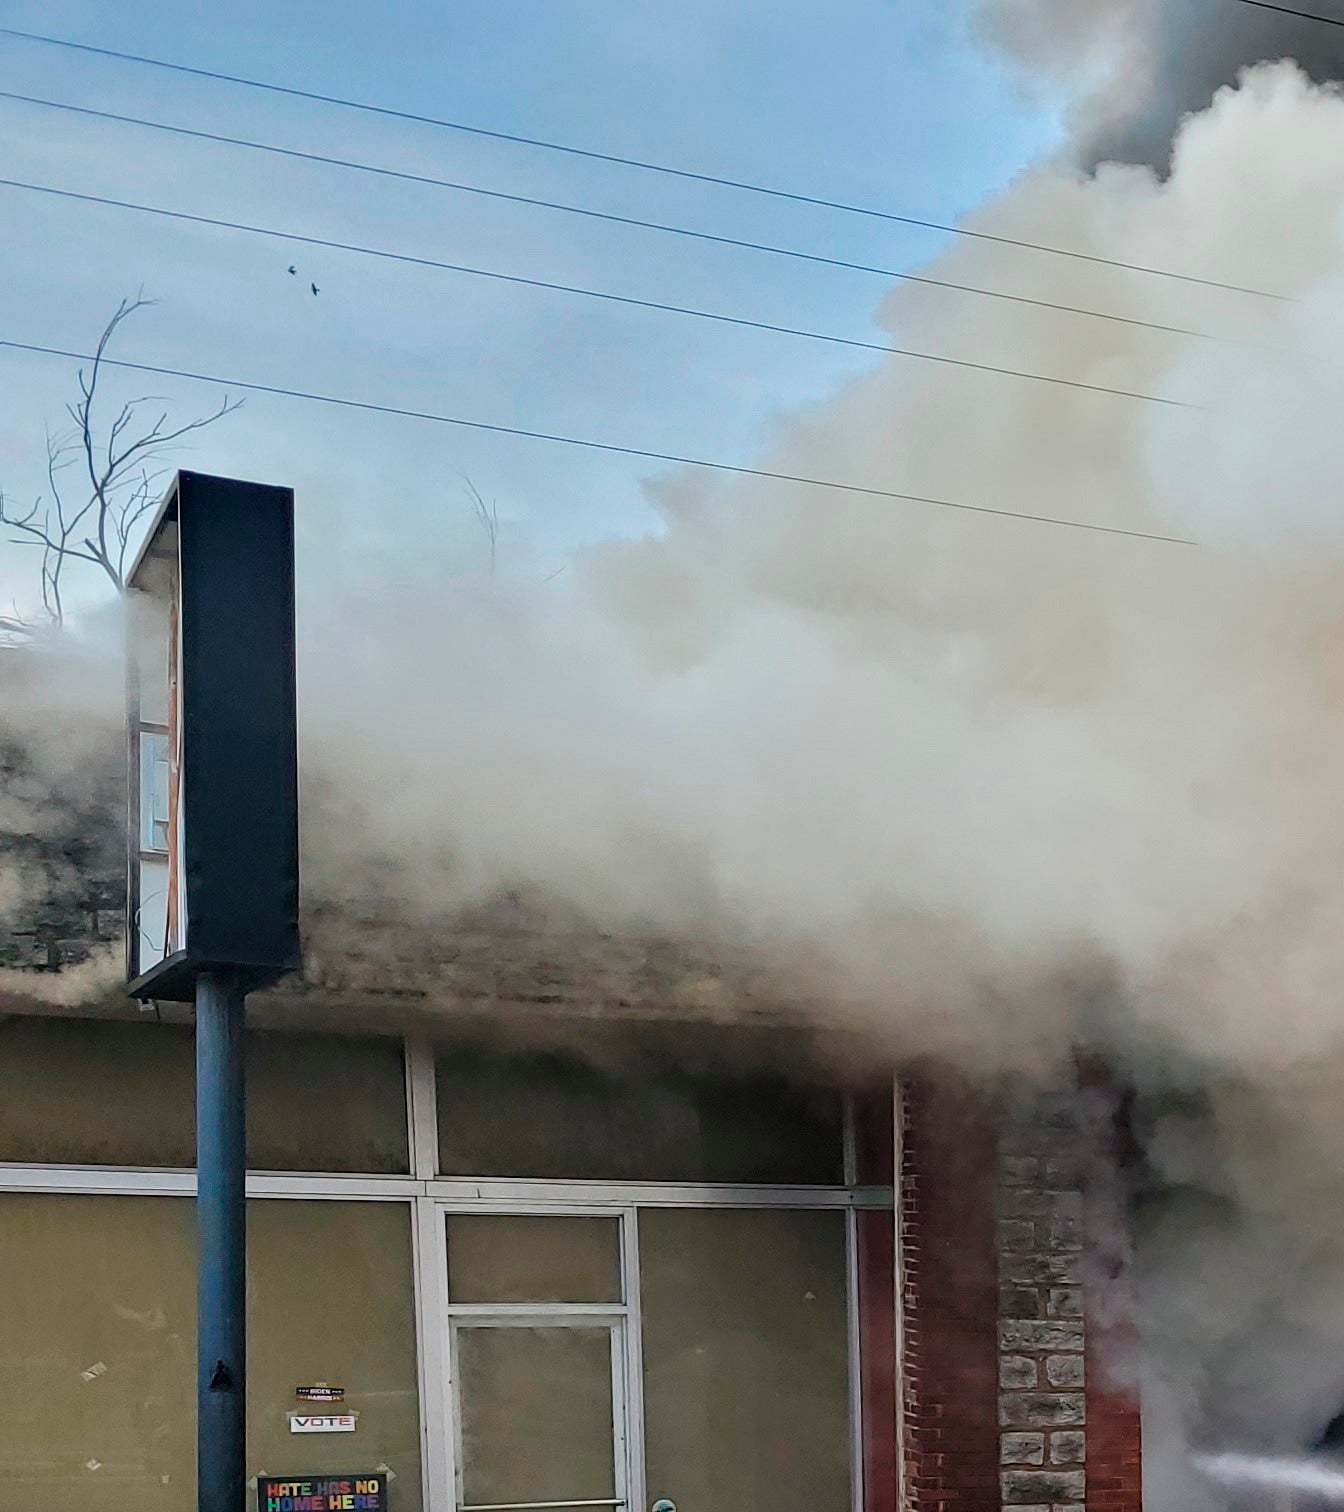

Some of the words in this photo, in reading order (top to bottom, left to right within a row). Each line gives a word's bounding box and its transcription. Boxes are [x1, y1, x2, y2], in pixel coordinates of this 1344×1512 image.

[295, 1417, 352, 1427] VOTE
[267, 1482, 312, 1497] HATE
[317, 1481, 351, 1495] HAS
[356, 1480, 379, 1494] NO
[267, 1496, 324, 1512] HOME
[329, 1494, 379, 1510] HERE
